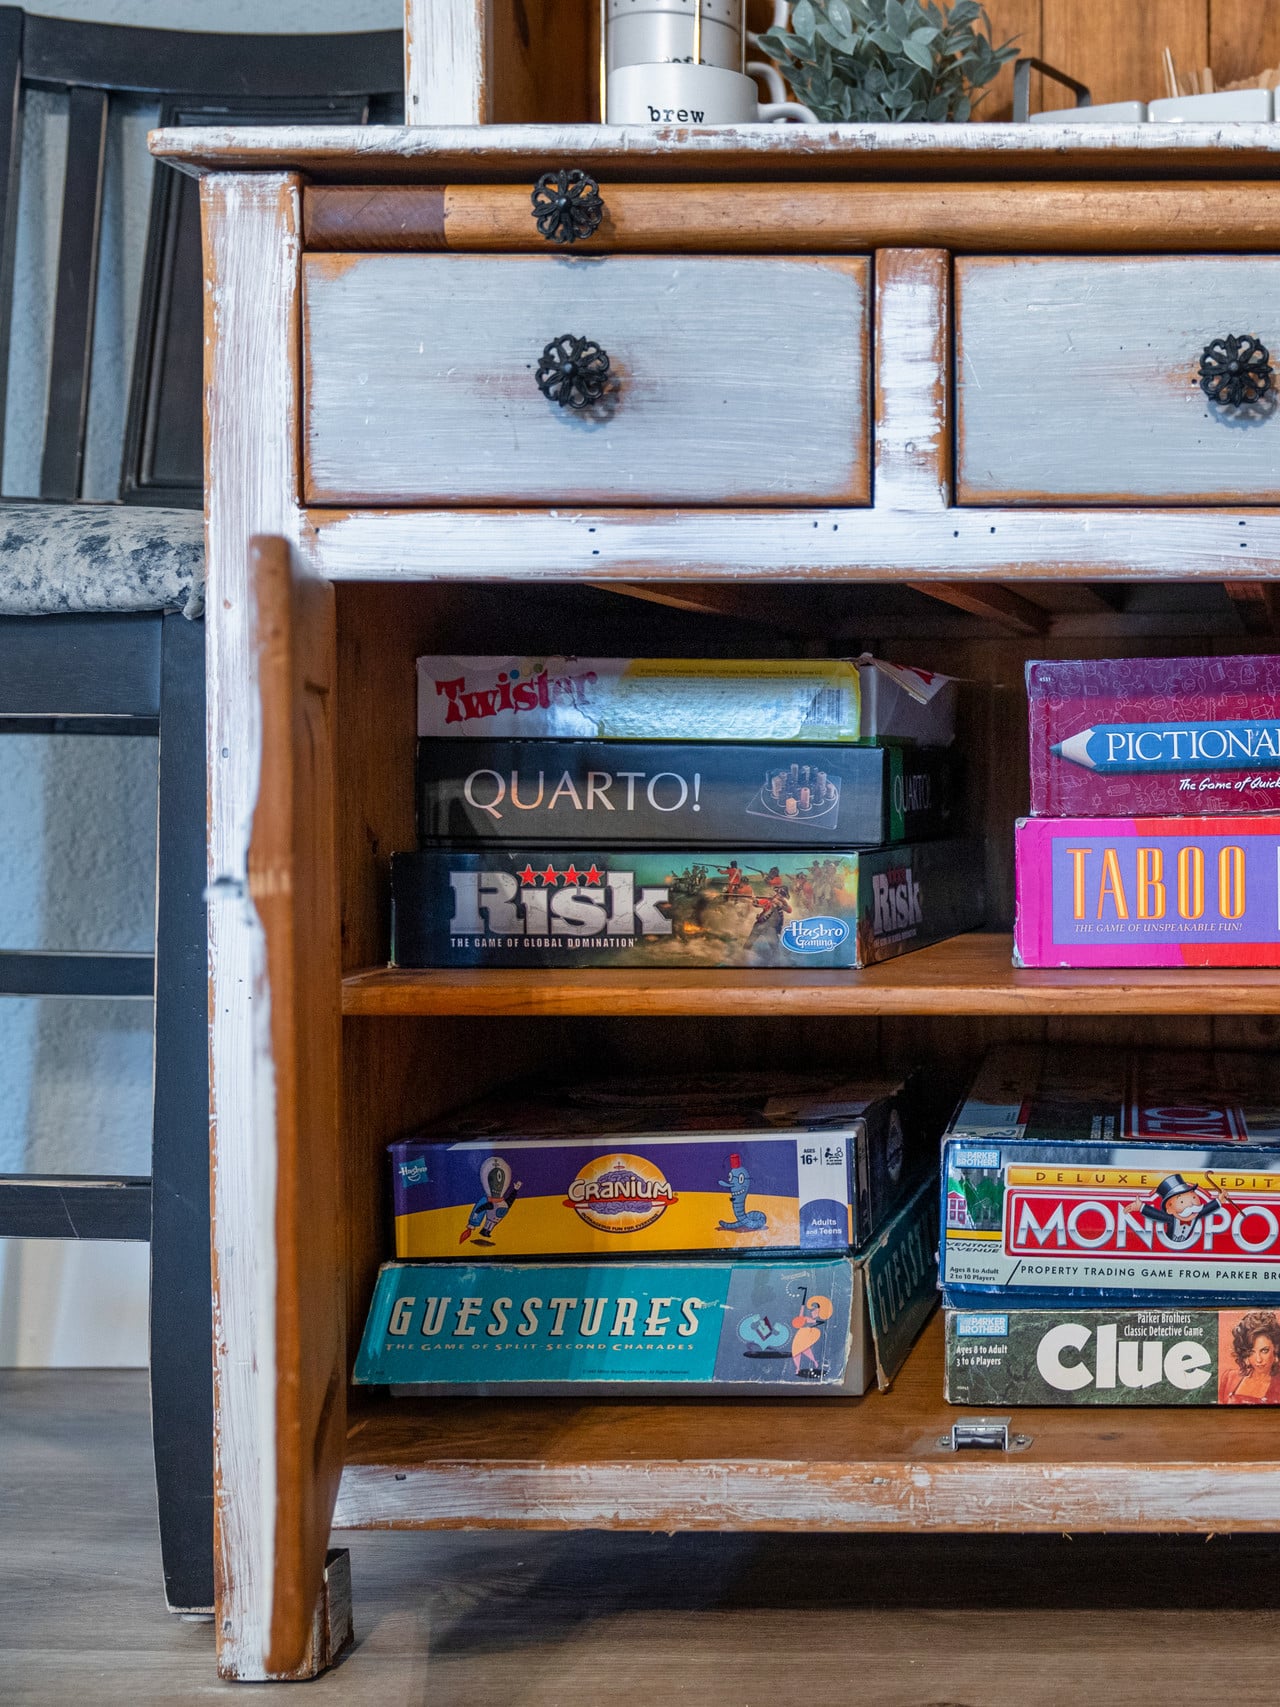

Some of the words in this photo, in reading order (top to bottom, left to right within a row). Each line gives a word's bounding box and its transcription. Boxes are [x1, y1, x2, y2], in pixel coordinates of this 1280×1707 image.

[647, 105, 705, 123] brew
[435, 669, 599, 724] Twister
[1179, 778, 1196, 791] The
[1198, 777, 1232, 791] Game
[1234, 777, 1251, 792] of
[463, 768, 701, 820] QUARTO!
[1065, 845, 1247, 920] TABOO
[785, 921, 843, 940] Hasbro
[1074, 923, 1094, 933] THE
[1097, 923, 1126, 932] GAME
[1127, 923, 1141, 932] OF
[1143, 923, 1216, 932] UNSPEAKABLE
[1218, 922, 1243, 932] FUN!
[451, 937, 469, 948] THE
[474, 937, 503, 948] GAME
[507, 937, 519, 948] OF
[523, 937, 563, 948] GLOBAL
[567, 937, 634, 948] DOMINATION
[796, 935, 836, 950] Gaming
[800, 1154, 819, 1165] 16+
[967, 1151, 998, 1160] PARKER
[956, 1159, 998, 1167] BROTHERS
[1035, 1172, 1148, 1185] DELUXE
[811, 1218, 837, 1226] Adults
[805, 1228, 818, 1236] and
[818, 1227, 843, 1235] Teens
[949, 1266, 966, 1275] Ages
[980, 1267, 1000, 1275] Adult
[1020, 1265, 1079, 1275] PROPERTY
[1084, 1267, 1135, 1277] TRADING
[1141, 1269, 1173, 1278] GAME
[1179, 1269, 1210, 1279] FROM
[1216, 1270, 1258, 1280] PARKER
[972, 1274, 996, 1282] Players
[387, 1297, 702, 1336] GUESSTURES
[971, 1317, 1006, 1326] PARKER
[1137, 1312, 1160, 1324] Parker
[1161, 1312, 1192, 1324] Brothers
[959, 1325, 1006, 1334] BROTHERS
[1123, 1325, 1148, 1337] Classic
[1149, 1325, 1182, 1337] Detective
[1183, 1325, 1204, 1337] Game
[385, 1342, 414, 1351] THE
[421, 1342, 465, 1351] GAME
[471, 1342, 490, 1350] OF
[494, 1342, 607, 1351] SPLIT-SECOND
[612, 1342, 695, 1351] CHARADES
[956, 1345, 973, 1356] Ages
[973, 1345, 978, 1354] 8
[979, 1345, 986, 1354] to
[988, 1344, 1008, 1354] Adult
[956, 1358, 961, 1367] 3
[961, 1357, 969, 1365] to
[970, 1357, 975, 1365] 6
[976, 1357, 1002, 1368] Players
[1036, 1323, 1212, 1391] Clue
